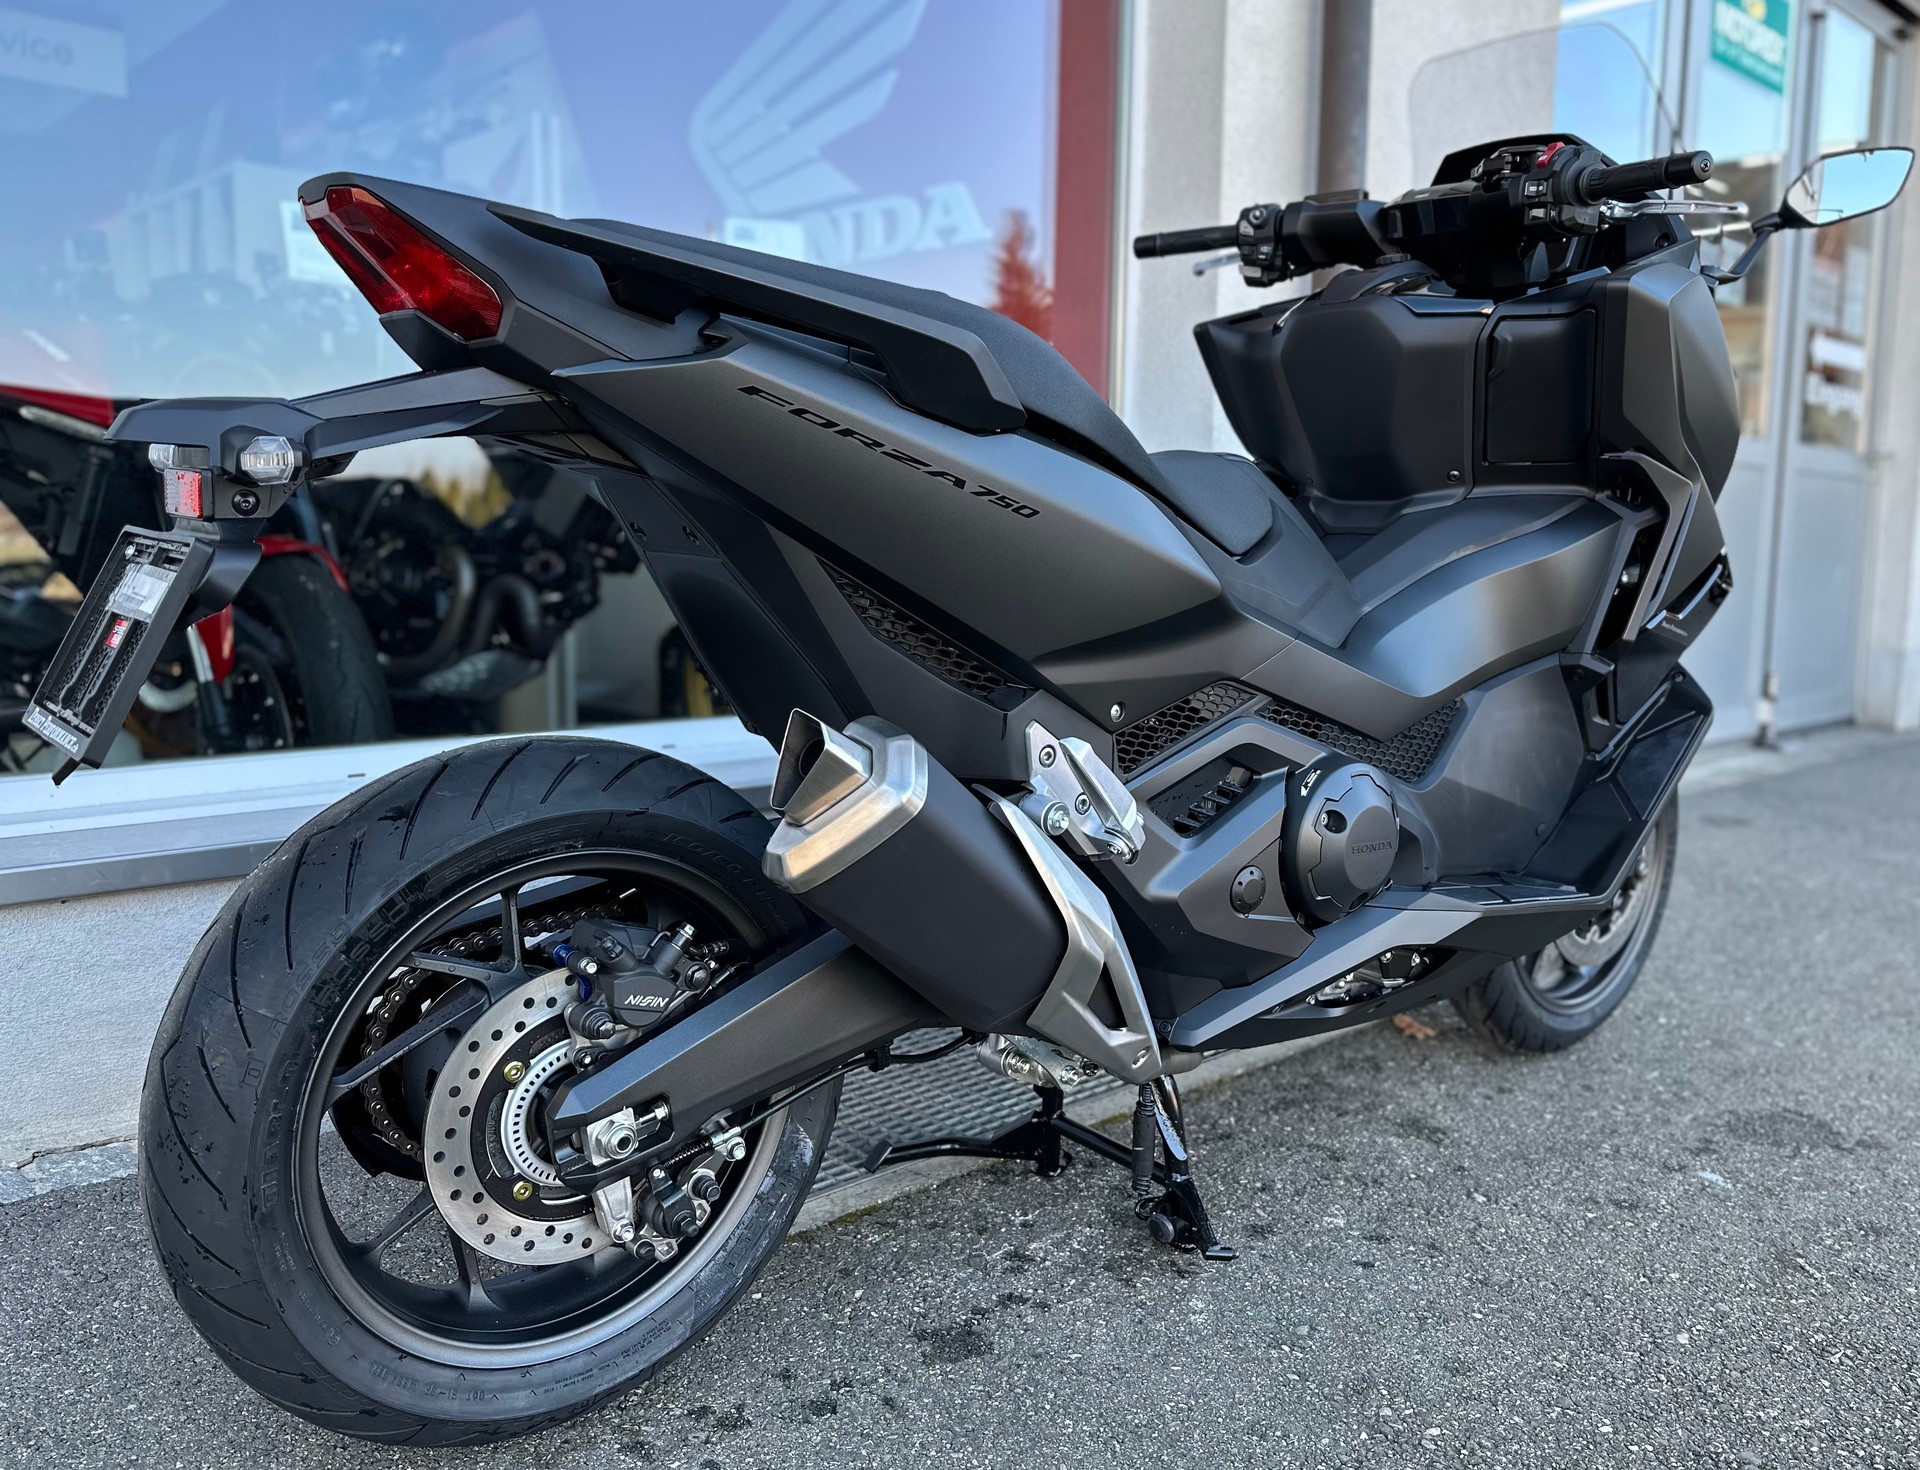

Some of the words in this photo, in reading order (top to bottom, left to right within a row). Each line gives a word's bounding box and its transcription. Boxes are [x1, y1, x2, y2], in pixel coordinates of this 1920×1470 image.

[0, 25, 76, 69] vice
[800, 181, 993, 268] NDA
[736, 385, 967, 490] FORZA
[969, 484, 1041, 519] 750
[1350, 840, 1393, 855] HONDA
